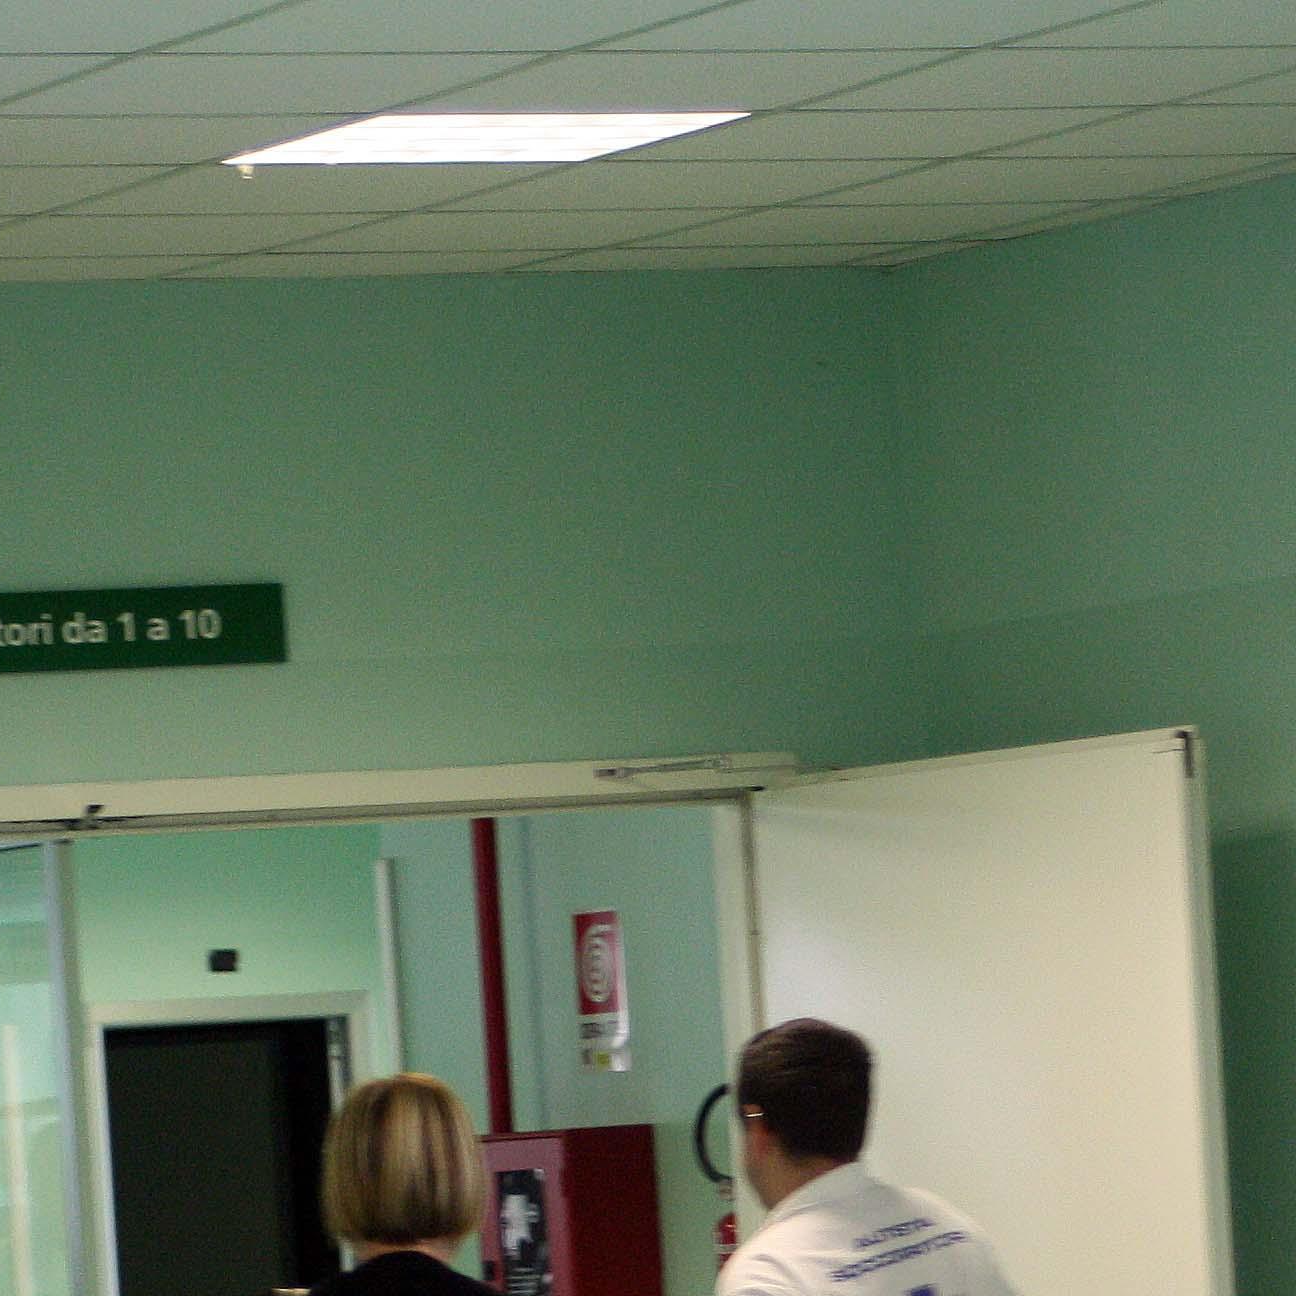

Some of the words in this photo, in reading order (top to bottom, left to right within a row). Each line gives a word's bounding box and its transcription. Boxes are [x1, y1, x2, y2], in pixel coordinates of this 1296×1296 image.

[62, 611, 108, 644] da
[116, 611, 136, 642] 1
[146, 617, 170, 641] a
[179, 608, 222, 640] 10
